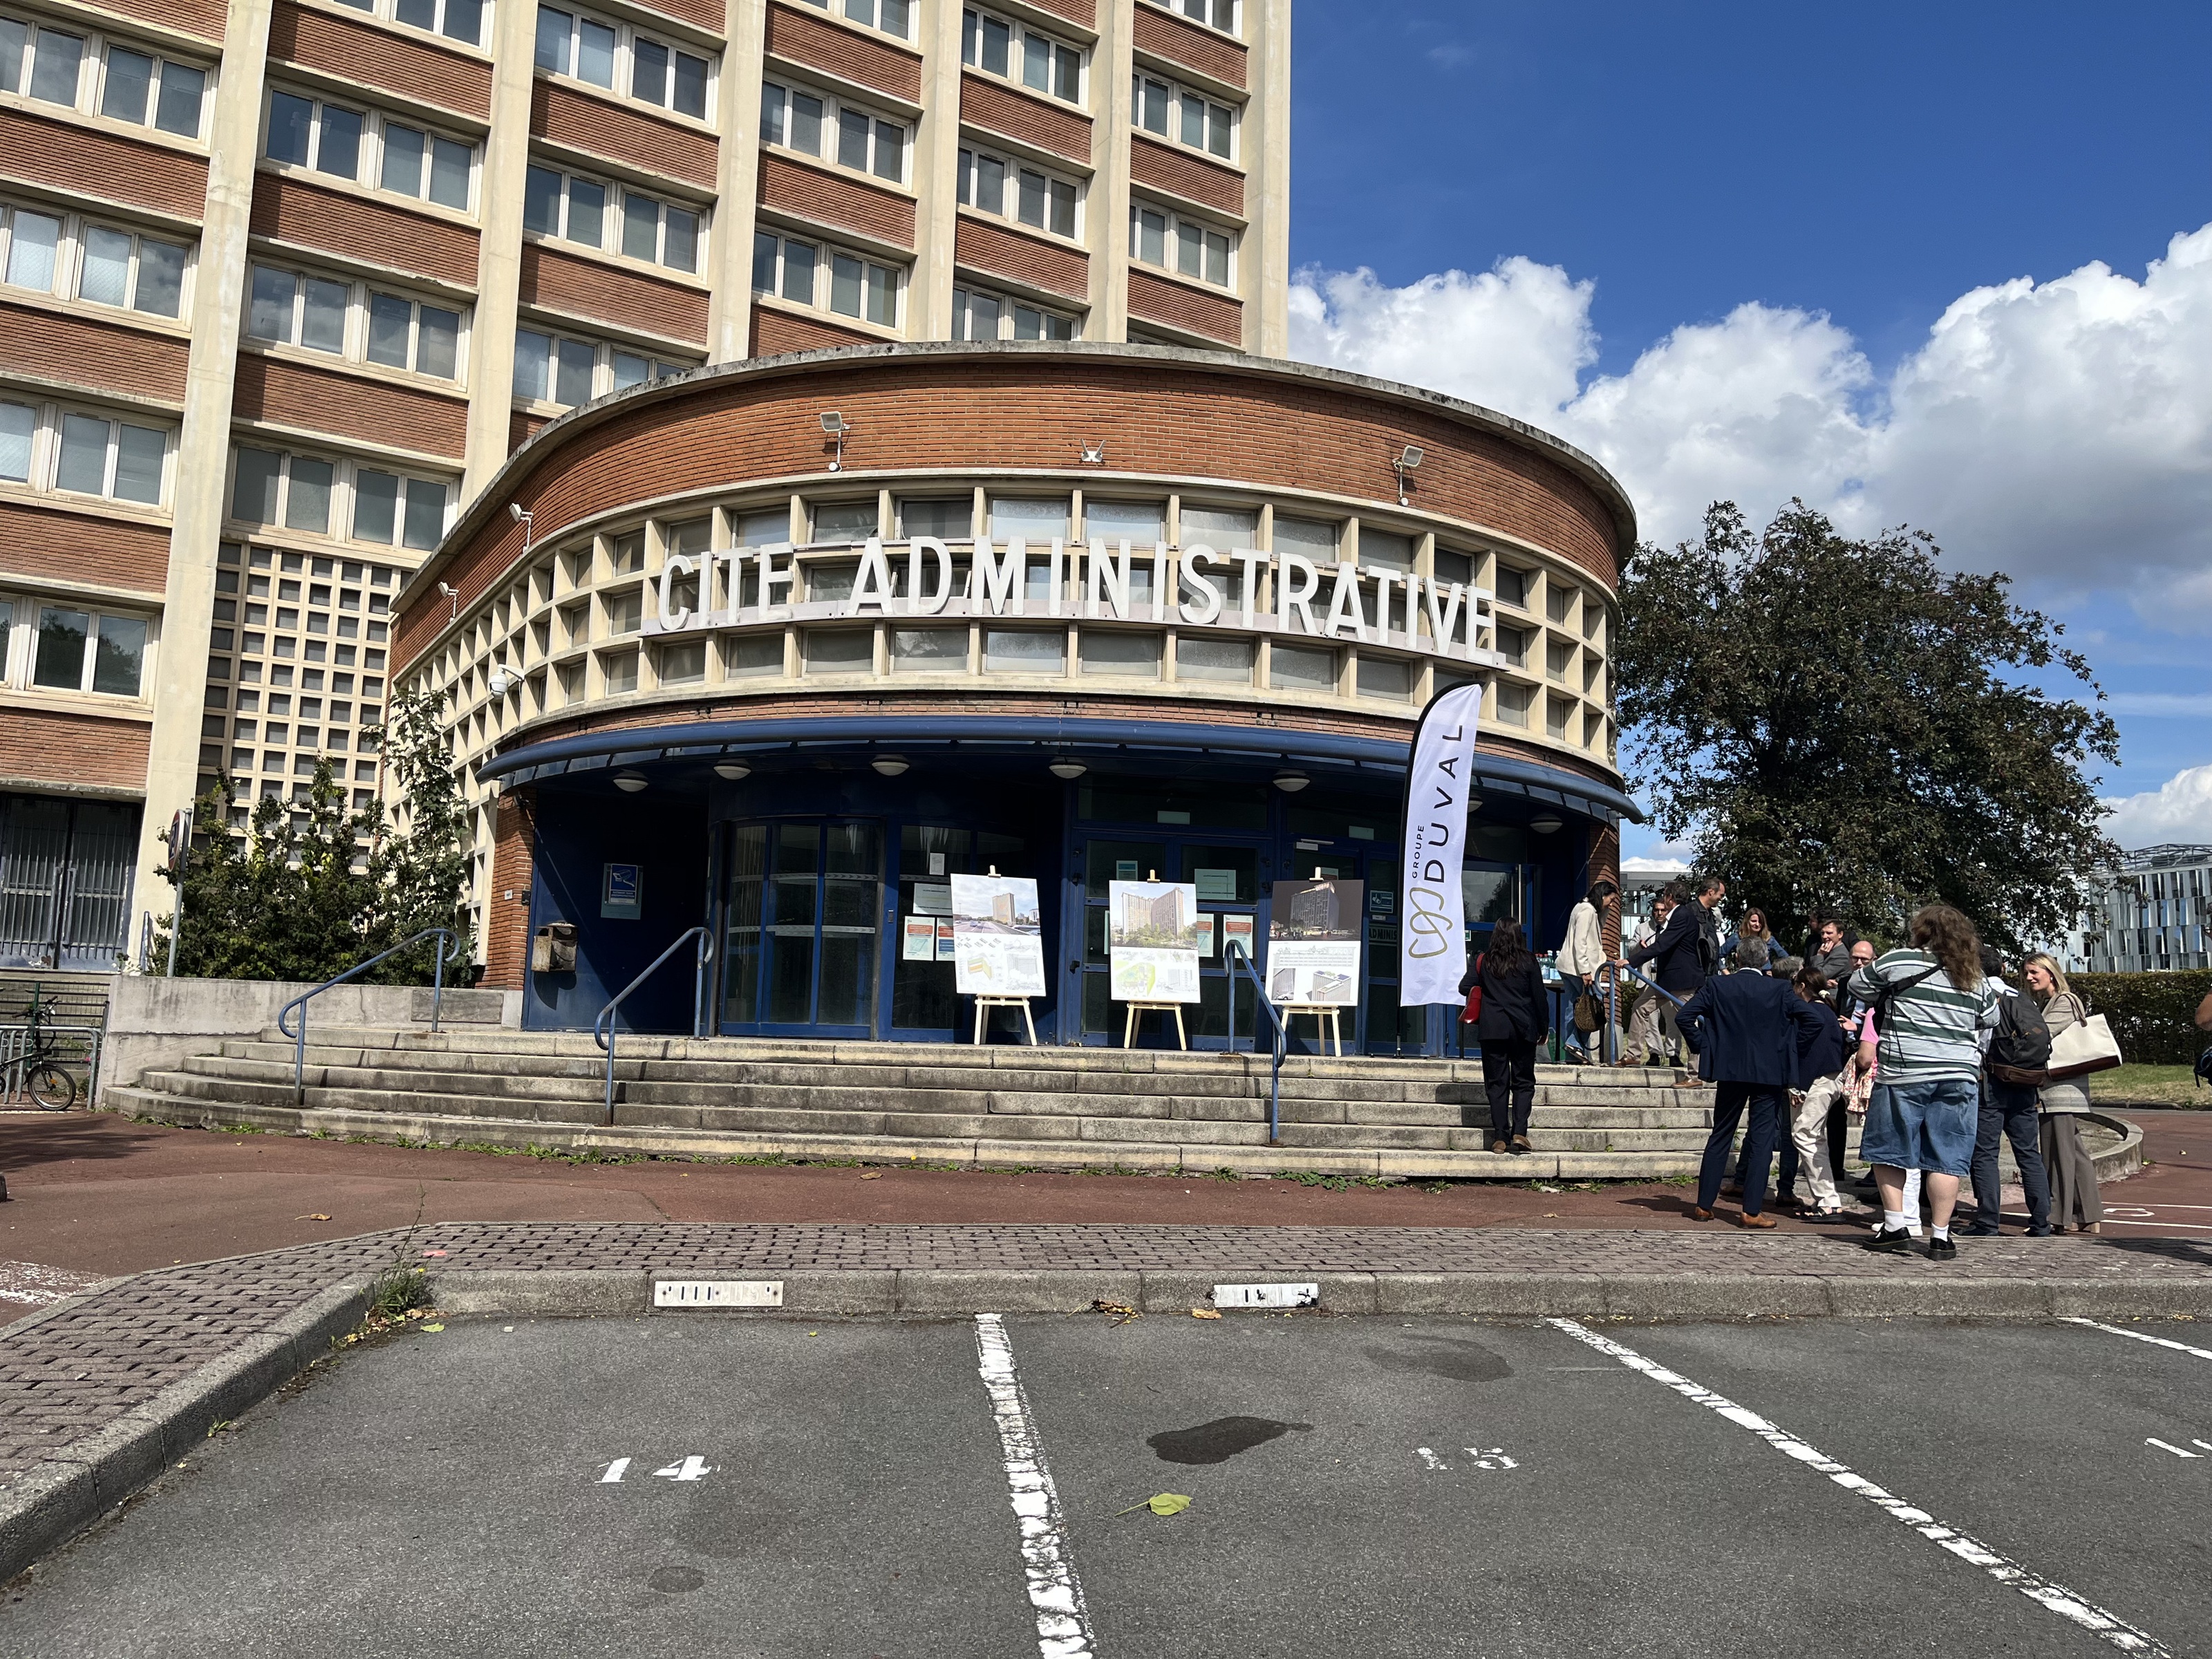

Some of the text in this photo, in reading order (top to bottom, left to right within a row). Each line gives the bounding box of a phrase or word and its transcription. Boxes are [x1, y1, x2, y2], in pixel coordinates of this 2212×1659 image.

[659, 535, 1498, 665] CITE ADMINISTRATIVE
[1423, 724, 1463, 883] DUVAL
[1411, 824, 1425, 879] GROUPE
[594, 1455, 721, 1484] 14
[1412, 1446, 1519, 1470] 15
